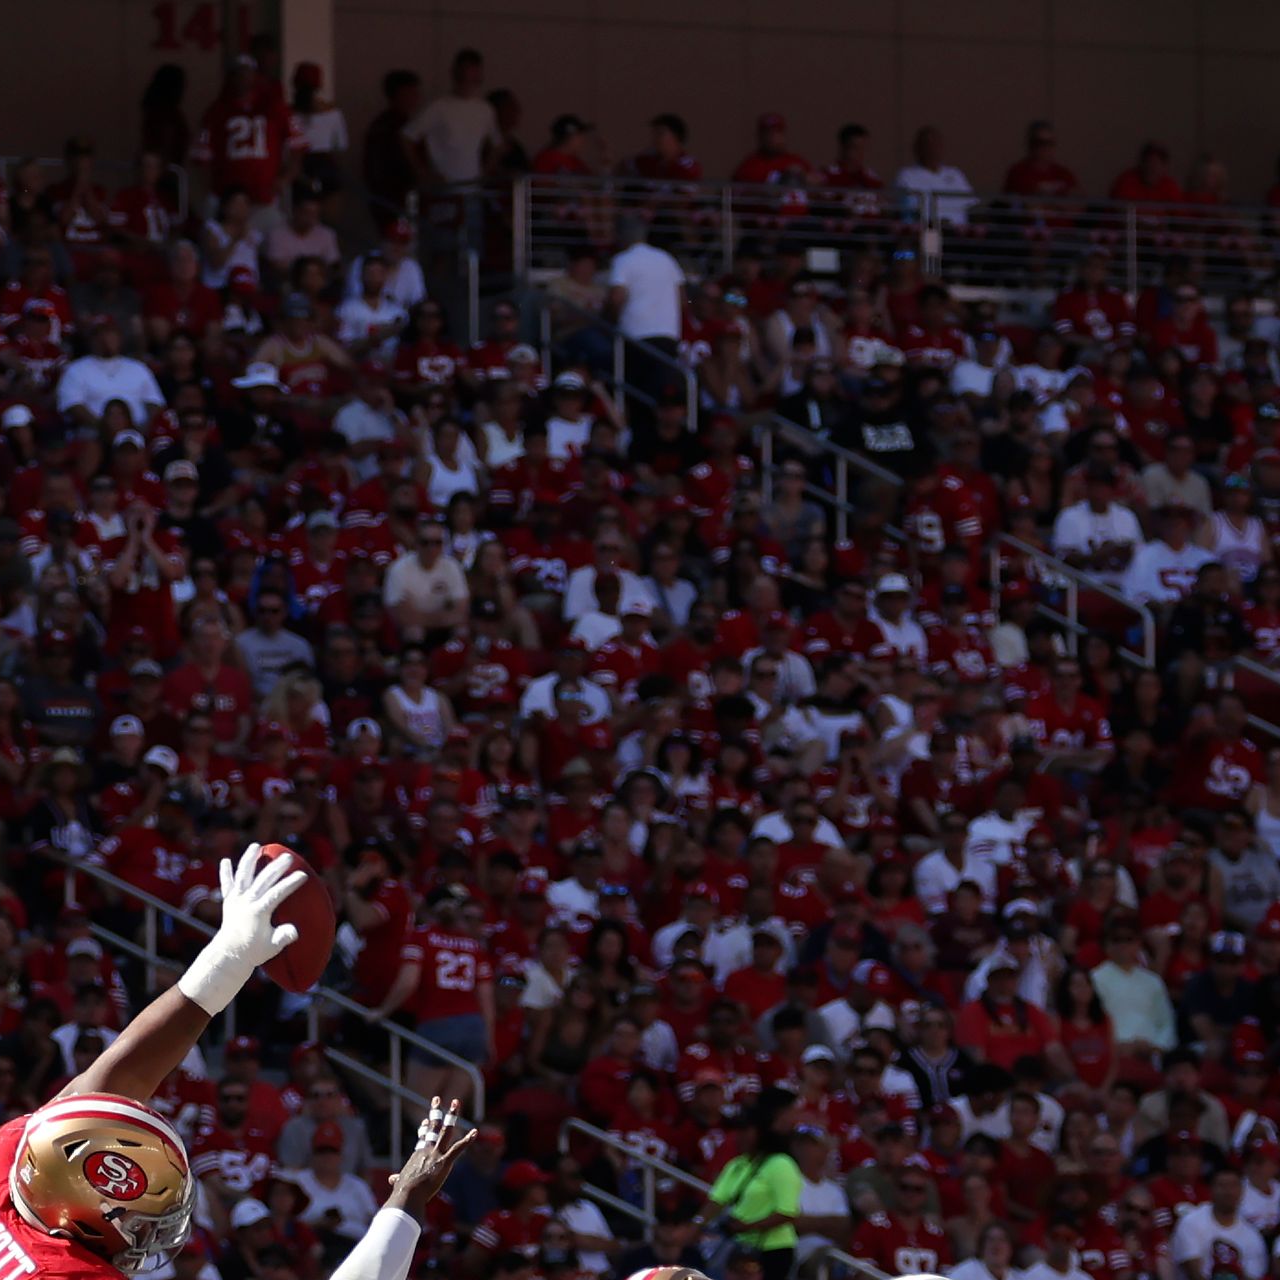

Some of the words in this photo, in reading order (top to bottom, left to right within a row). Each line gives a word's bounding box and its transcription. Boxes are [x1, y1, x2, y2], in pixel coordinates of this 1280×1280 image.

[224, 115, 269, 160] 21
[434, 951, 477, 992] 23
[97, 1154, 138, 1196] SF
[217, 1150, 270, 1191] 54
